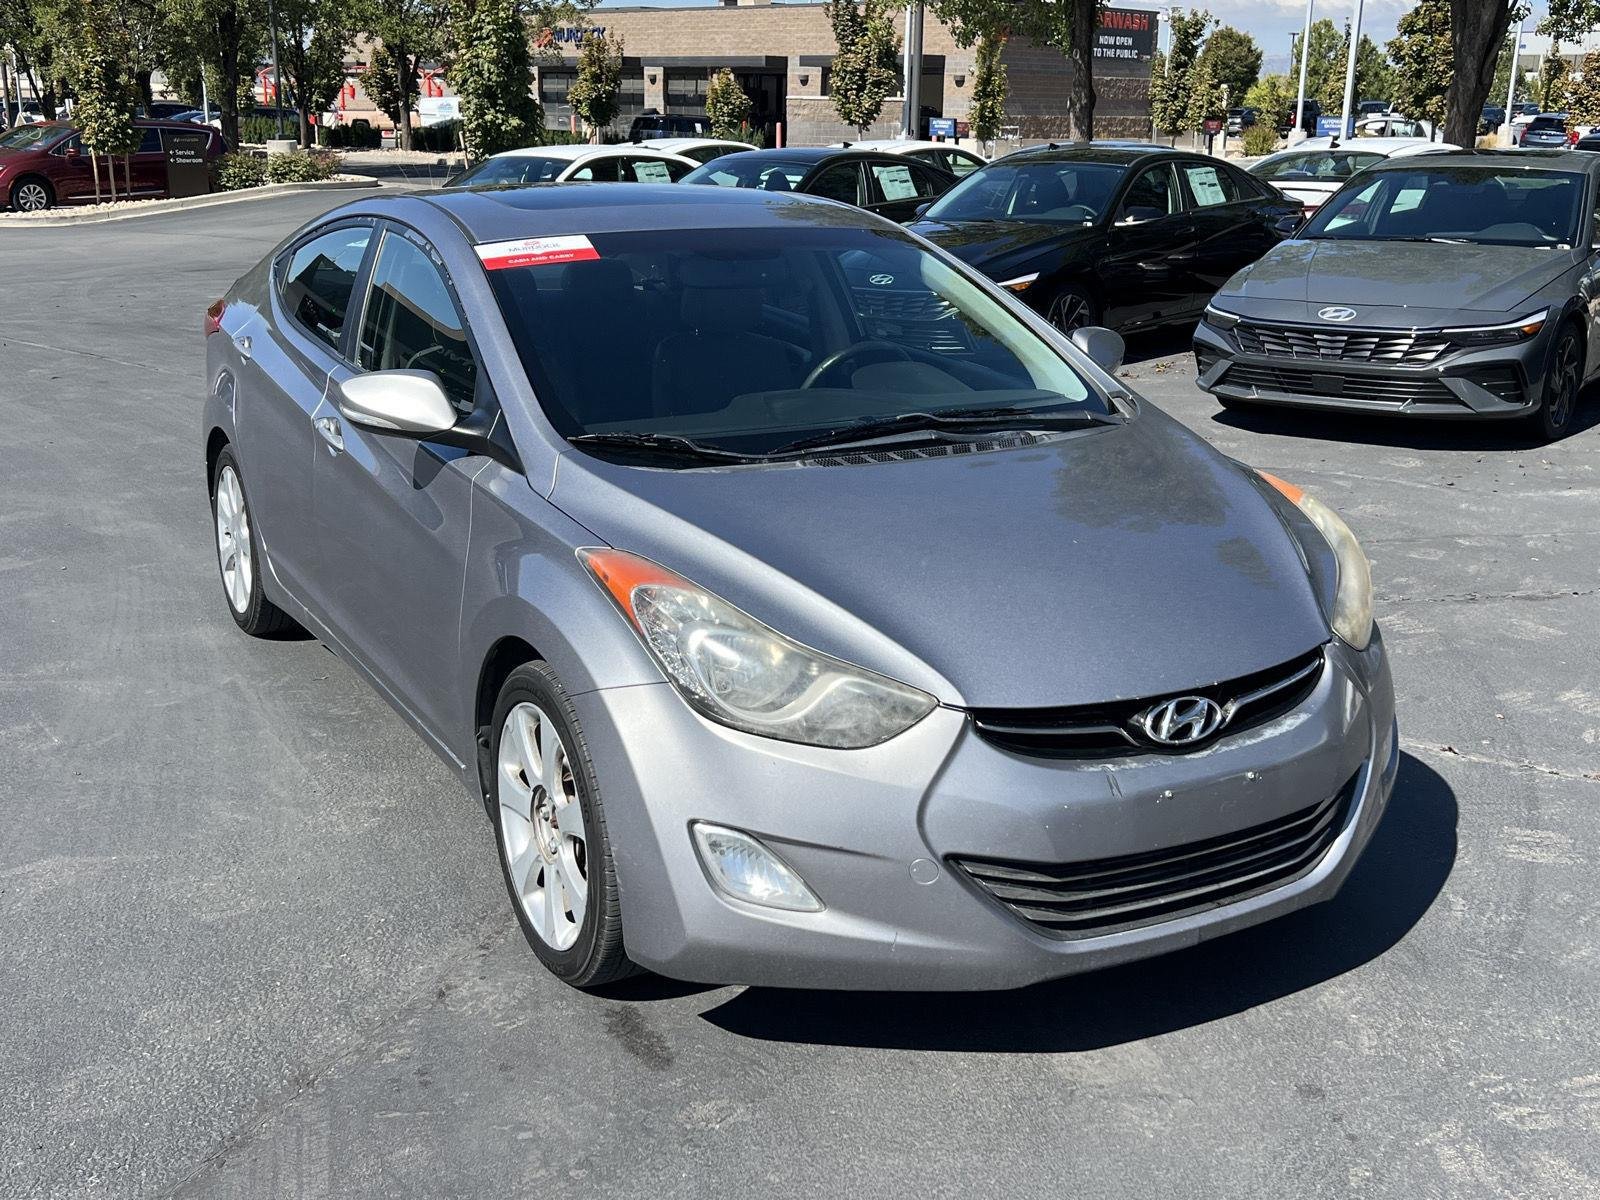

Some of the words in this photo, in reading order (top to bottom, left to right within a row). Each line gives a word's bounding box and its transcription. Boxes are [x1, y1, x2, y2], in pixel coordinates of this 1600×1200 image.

[553, 26, 606, 42] MURDK
[1099, 35, 1115, 45] NOW
[1116, 36, 1133, 46] OPEN
[1093, 47, 1102, 57] TO
[1103, 48, 1115, 58] THE
[1116, 49, 1138, 59] PUBLIC
